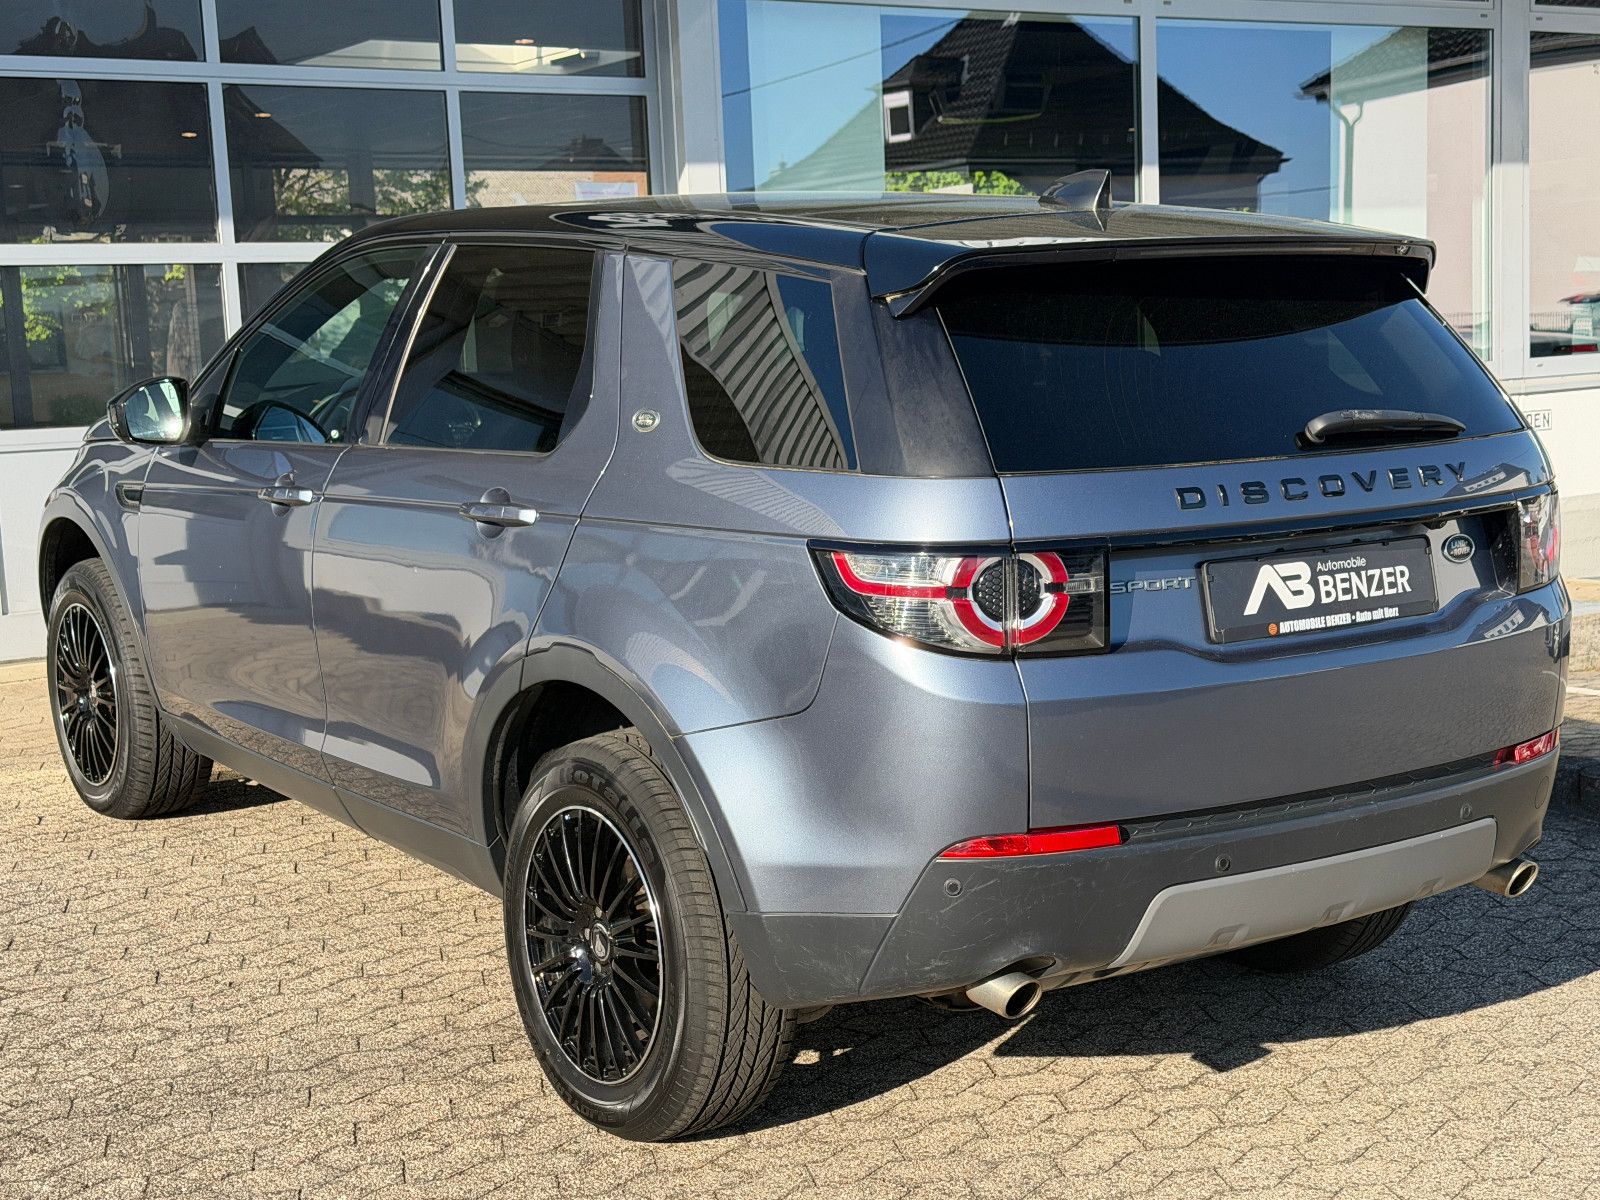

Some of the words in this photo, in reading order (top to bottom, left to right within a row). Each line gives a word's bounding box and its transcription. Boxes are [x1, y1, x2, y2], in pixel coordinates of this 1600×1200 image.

[1174, 461, 1466, 510] DISCOVERY
[1316, 556, 1367, 573] Automobile
[1110, 576, 1196, 594] SPORT
[1317, 565, 1412, 604] BENZER
[1279, 616, 1326, 634] AUTOMOBILE
[1326, 612, 1352, 628] BENZER
[1355, 610, 1372, 622] Auto
[1372, 608, 1384, 619] mit
[1384, 606, 1400, 618] Herz
